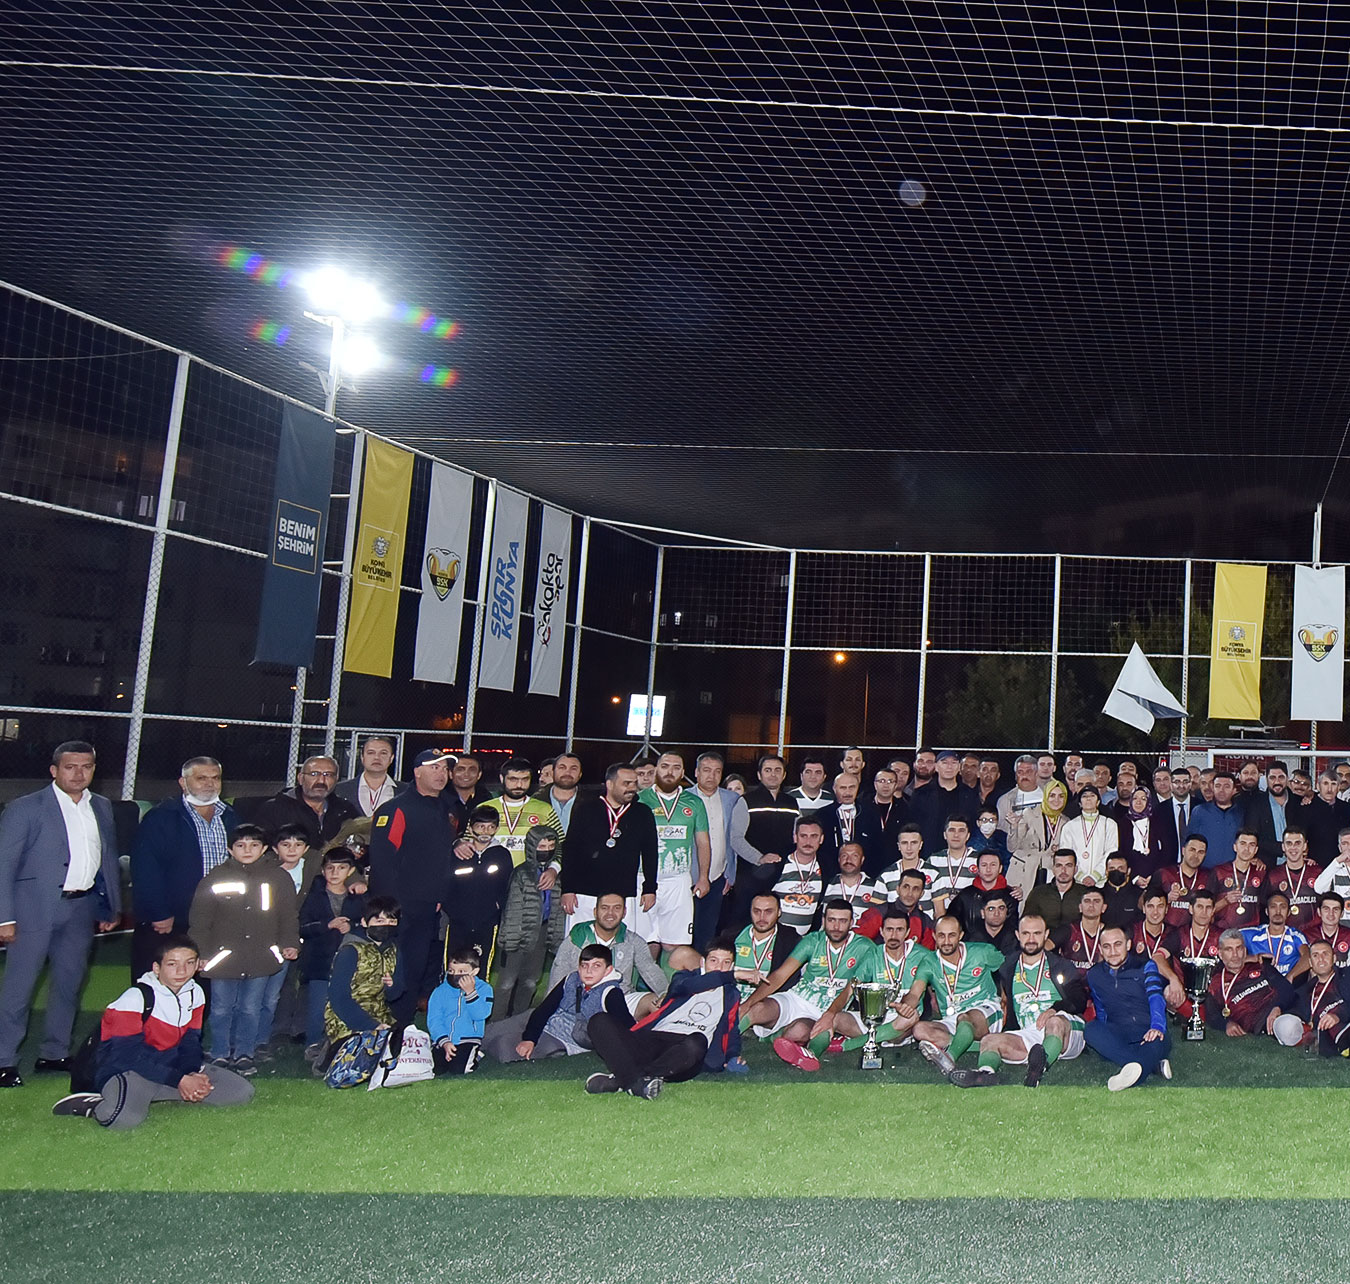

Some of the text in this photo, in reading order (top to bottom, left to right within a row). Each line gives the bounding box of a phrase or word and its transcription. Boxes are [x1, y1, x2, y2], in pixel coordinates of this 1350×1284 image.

[279, 517, 316, 540] BENİM
[277, 536, 315, 556] ŞEHRİM
[491, 557, 506, 640] SPOR
